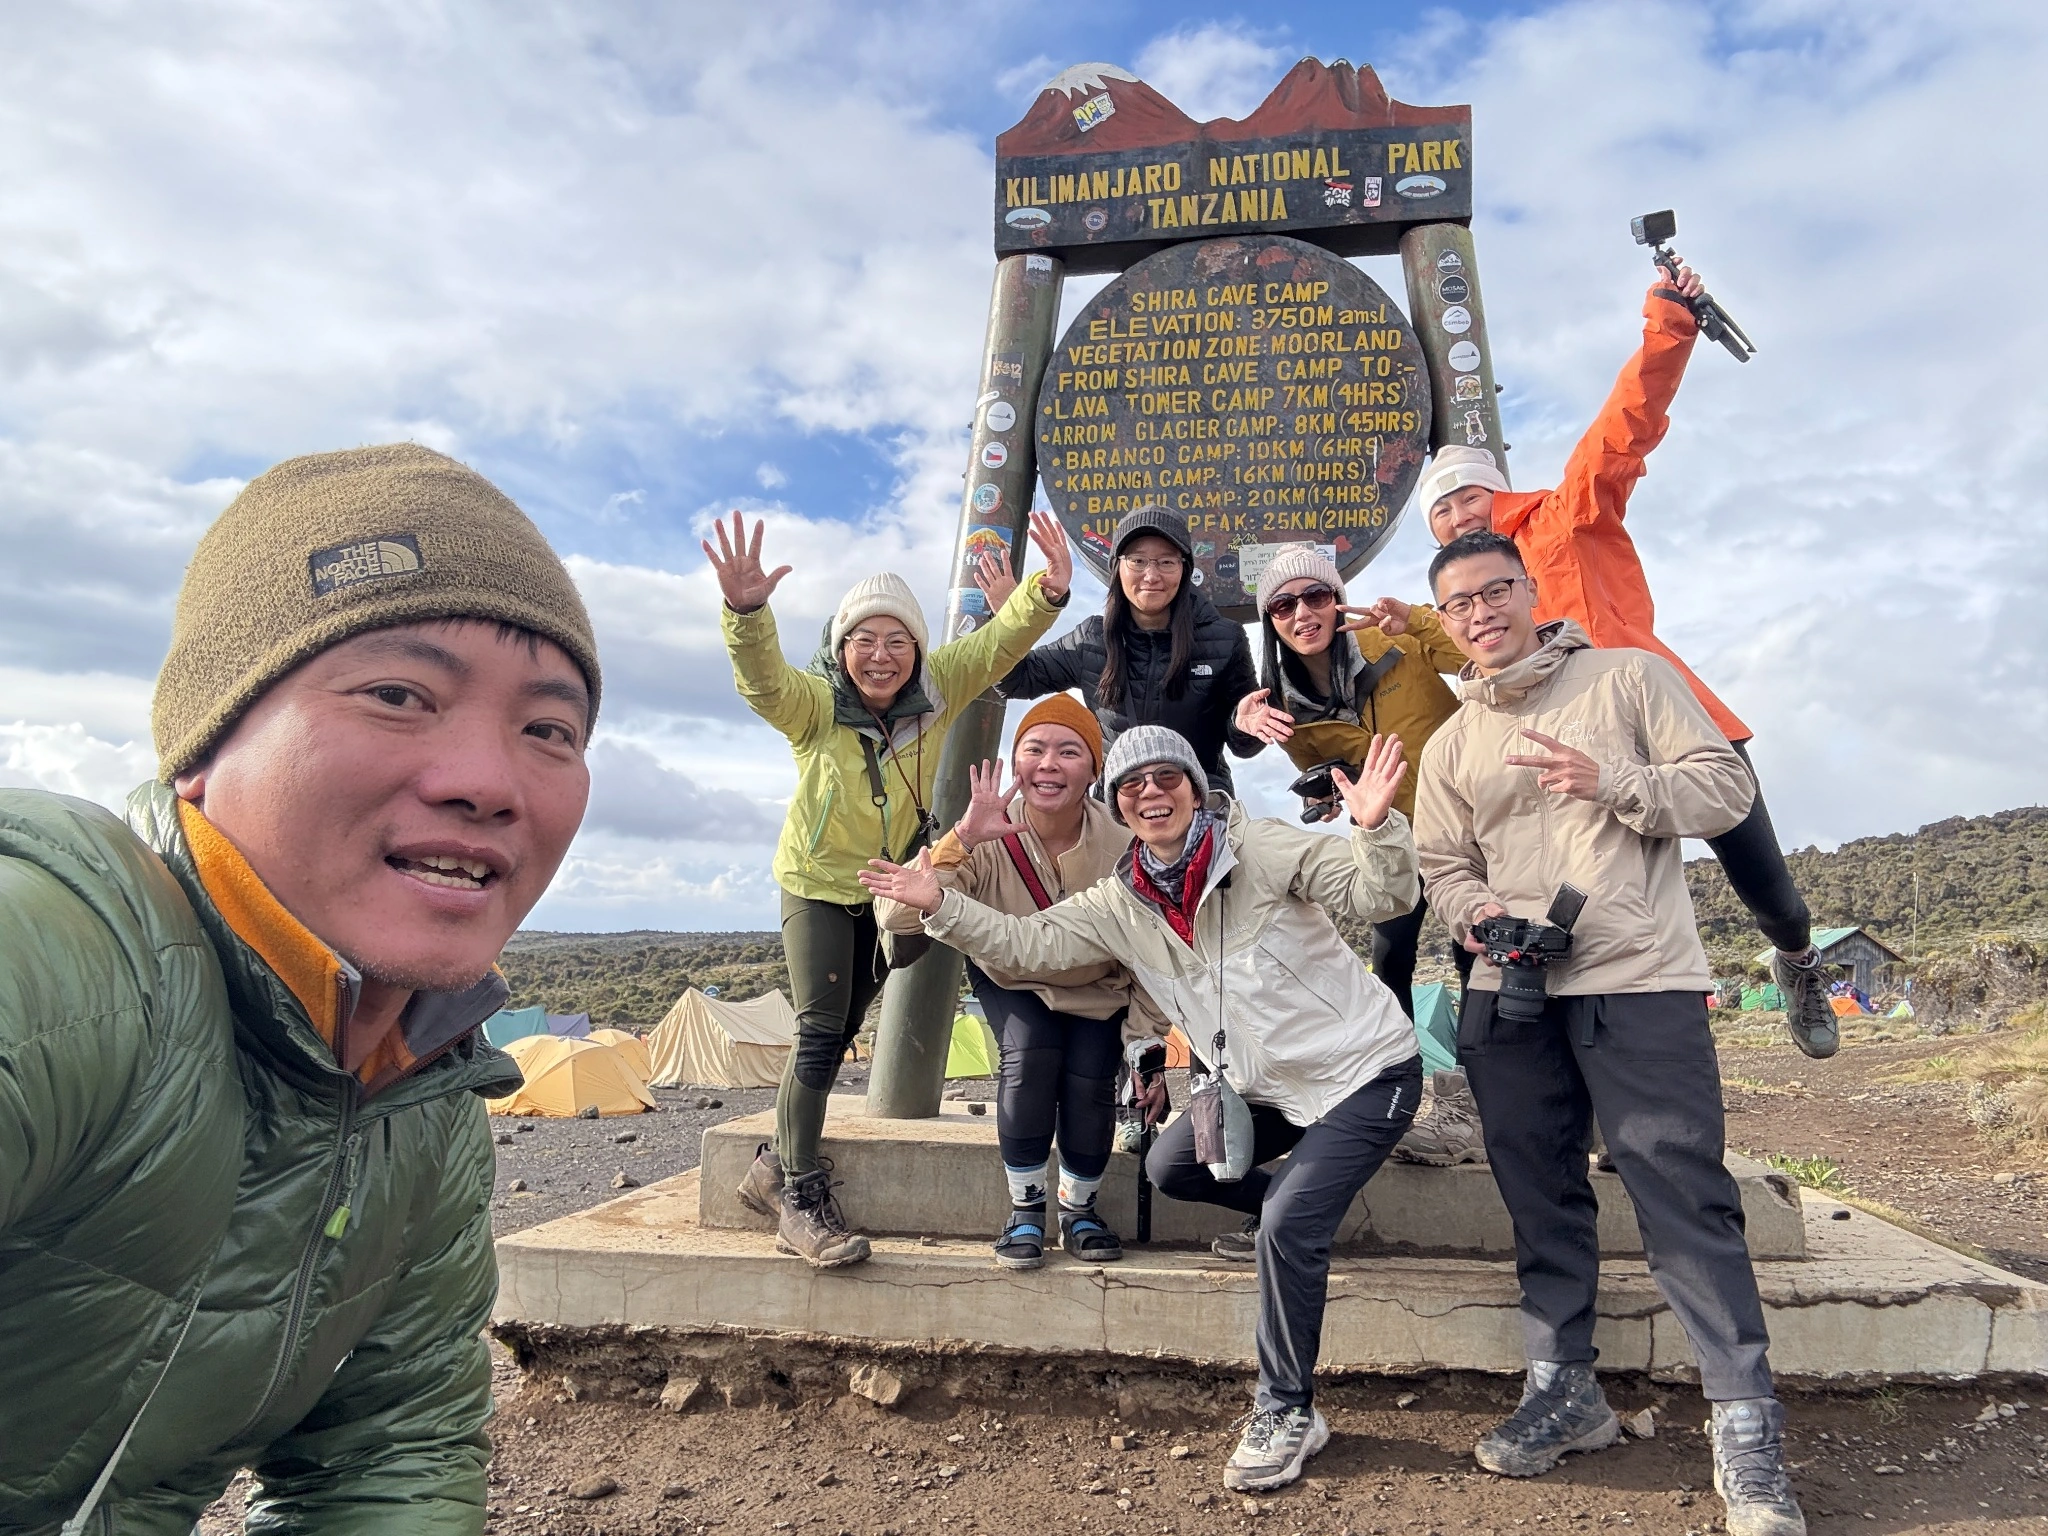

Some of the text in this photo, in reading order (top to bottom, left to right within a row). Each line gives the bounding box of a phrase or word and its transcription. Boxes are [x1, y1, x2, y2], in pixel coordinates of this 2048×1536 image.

[1006, 140, 1462, 207] KILIMANJARO NATIONAL PARK
[1148, 187, 1288, 229] TANZANIA
[1133, 282, 1329, 312] SHIRA CAVE CAMP
[1090, 304, 1386, 340] ELEVATION: 3750M amsl
[1069, 339, 1200, 366] VEGETATION
[1271, 330, 1401, 354] MOORLAND
[1059, 370, 1117, 392] FROM
[1124, 364, 1191, 389] SHIRA
[1204, 361, 1258, 384] CAVE
[1277, 358, 1342, 380] CAMP
[1055, 396, 1109, 420] LAVA
[1126, 391, 1200, 414] TOWER
[1211, 388, 1274, 412] CAMP
[1052, 423, 1116, 446] ARROW
[1135, 419, 1219, 442] GLACIER
[1295, 413, 1336, 434] 8KM
[1248, 441, 1304, 459] 10KM
[1067, 470, 1153, 492] KARANGA
[1234, 464, 1284, 484] 16KM
[1088, 493, 1168, 514] BARAFU
[340, 542, 377, 559] THE
[315, 551, 379, 582] NORTH
[334, 564, 382, 586] FACE
